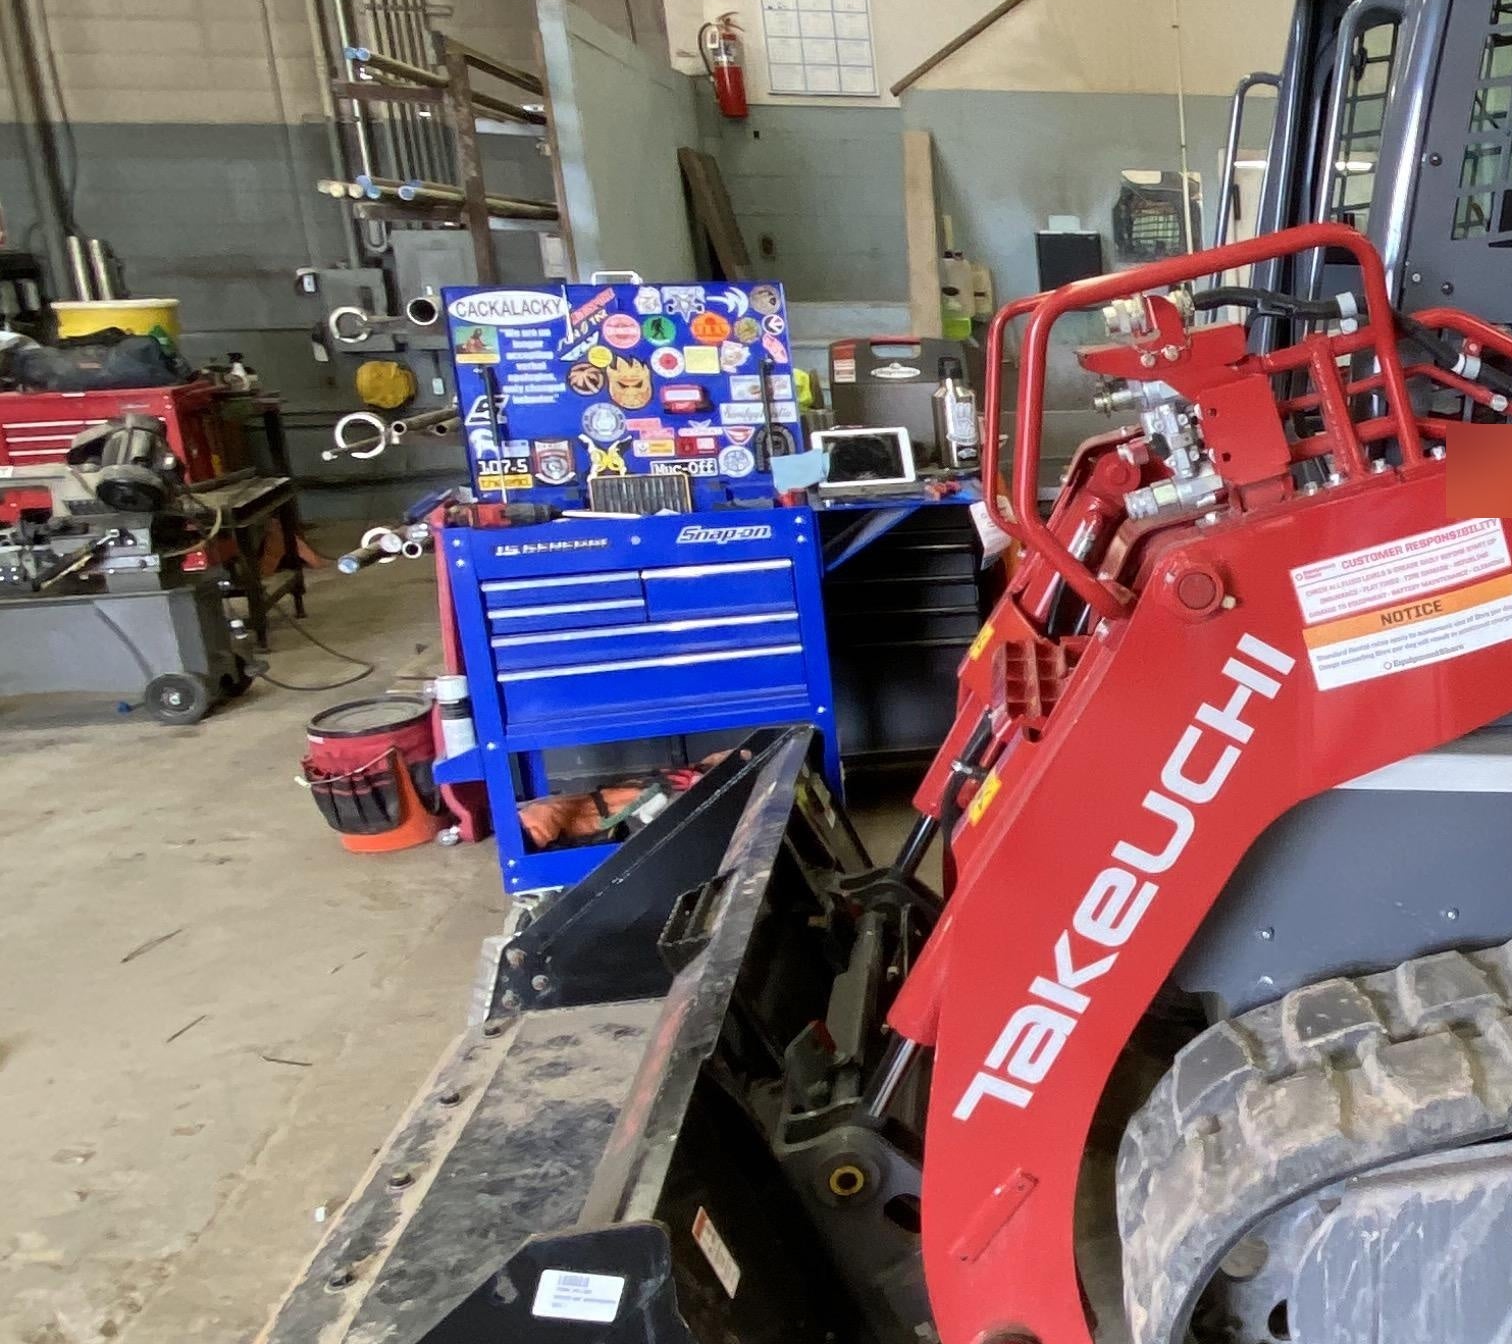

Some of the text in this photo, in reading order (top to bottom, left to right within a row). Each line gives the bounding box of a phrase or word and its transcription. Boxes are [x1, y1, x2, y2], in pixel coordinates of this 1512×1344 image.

[455, 299, 562, 318] CACKALACKY
[654, 459, 716, 475] Muc-Off
[679, 526, 768, 544] Snap-on
[1340, 517, 1497, 569] CUSTOMER RESPONSIBILITY
[1380, 598, 1443, 627] NOTICE
[952, 632, 1296, 1121] TAKEUCHI
